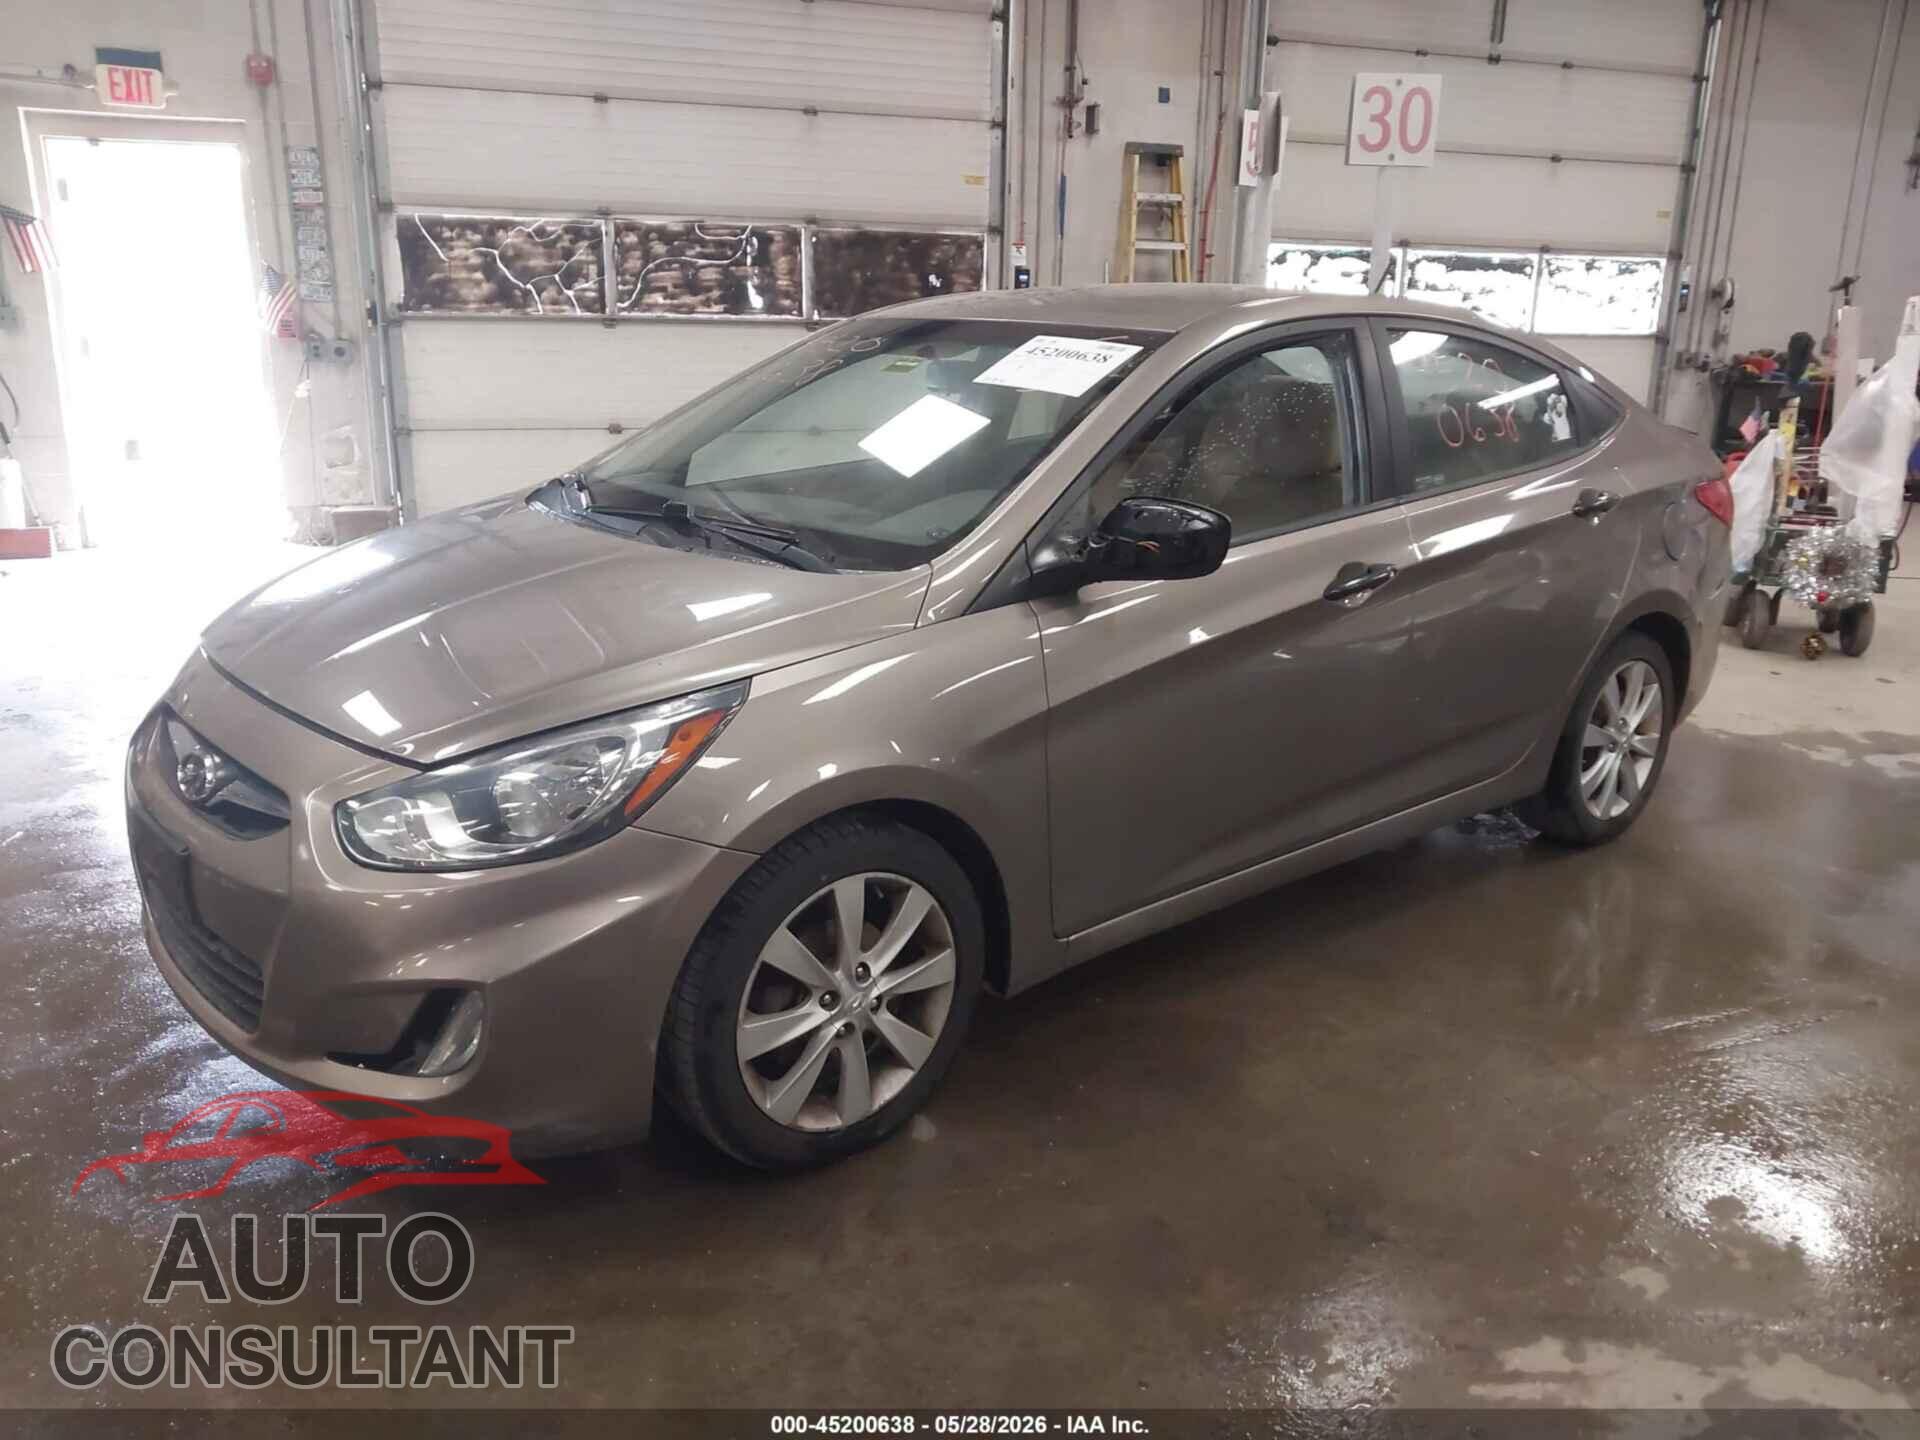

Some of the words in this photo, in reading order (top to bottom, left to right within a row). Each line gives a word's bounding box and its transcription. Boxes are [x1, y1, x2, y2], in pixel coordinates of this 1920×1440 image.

[107, 67, 154, 104] EXIT
[1357, 85, 1433, 154] 30
[1025, 344, 1114, 364] 45200638
